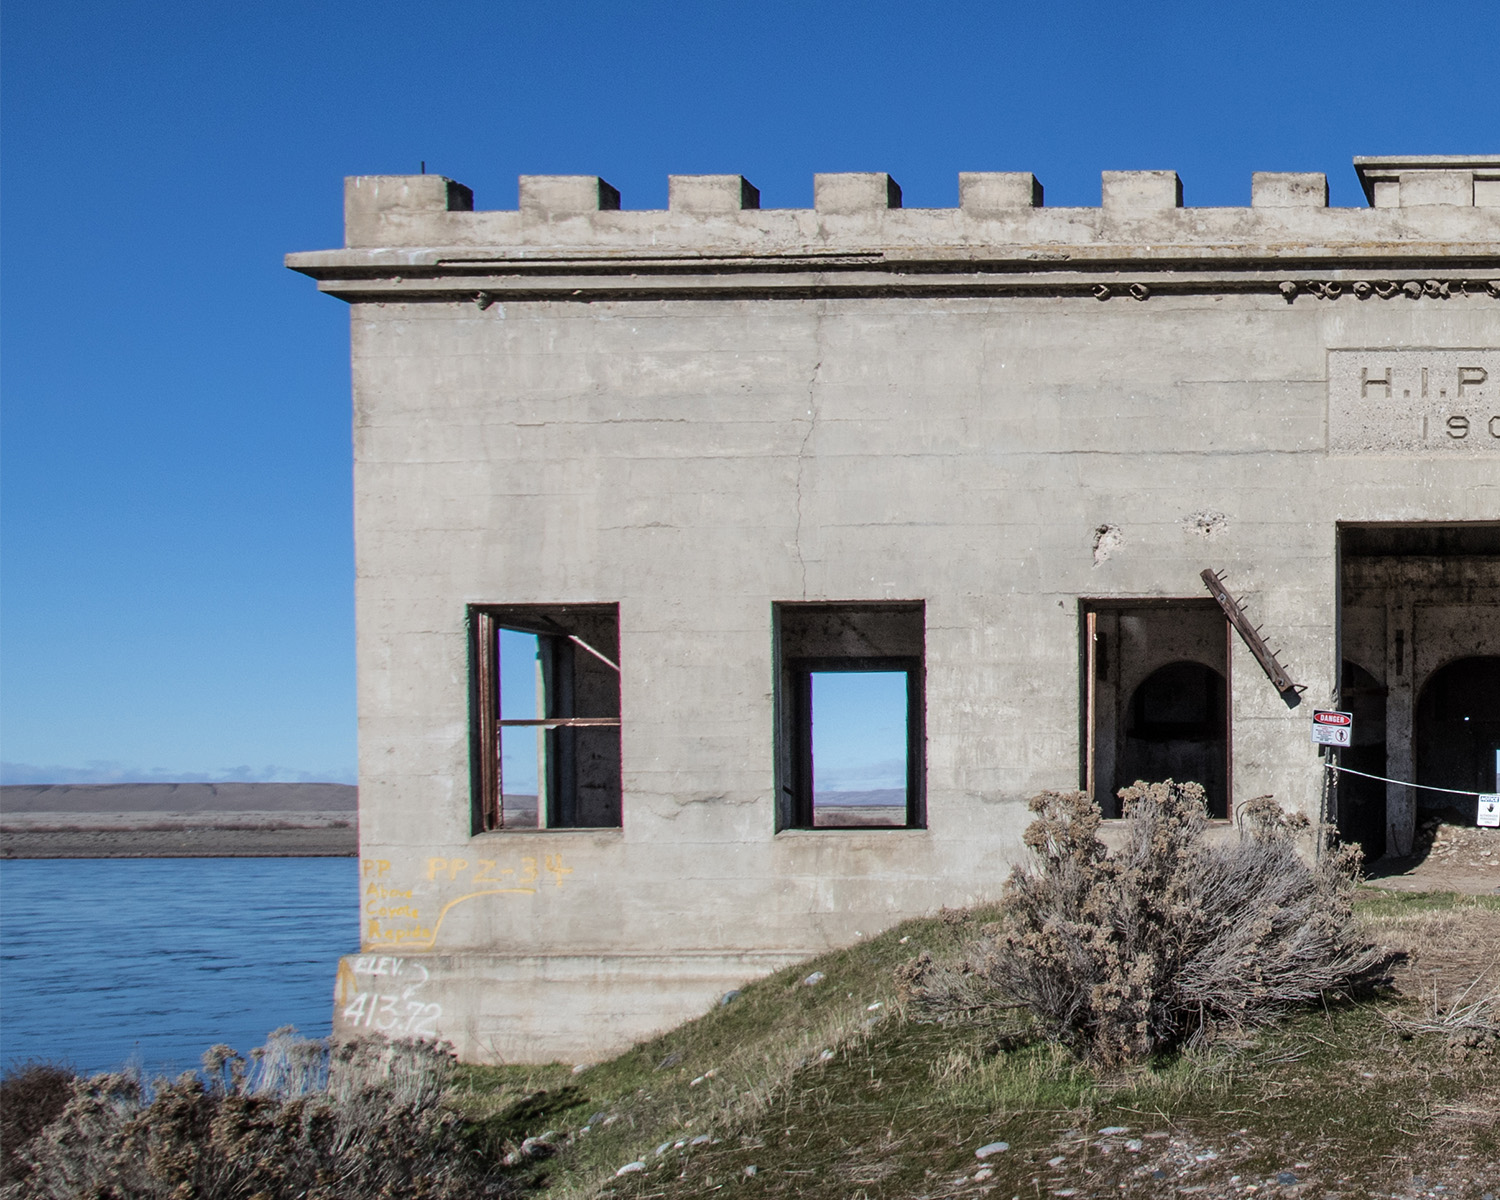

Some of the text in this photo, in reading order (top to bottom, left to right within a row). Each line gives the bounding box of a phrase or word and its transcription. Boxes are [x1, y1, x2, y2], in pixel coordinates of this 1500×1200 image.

[1320, 714, 1344, 723] DANGER
[354, 957, 403, 976] ELEV.
[342, 992, 442, 1036] 413.72
